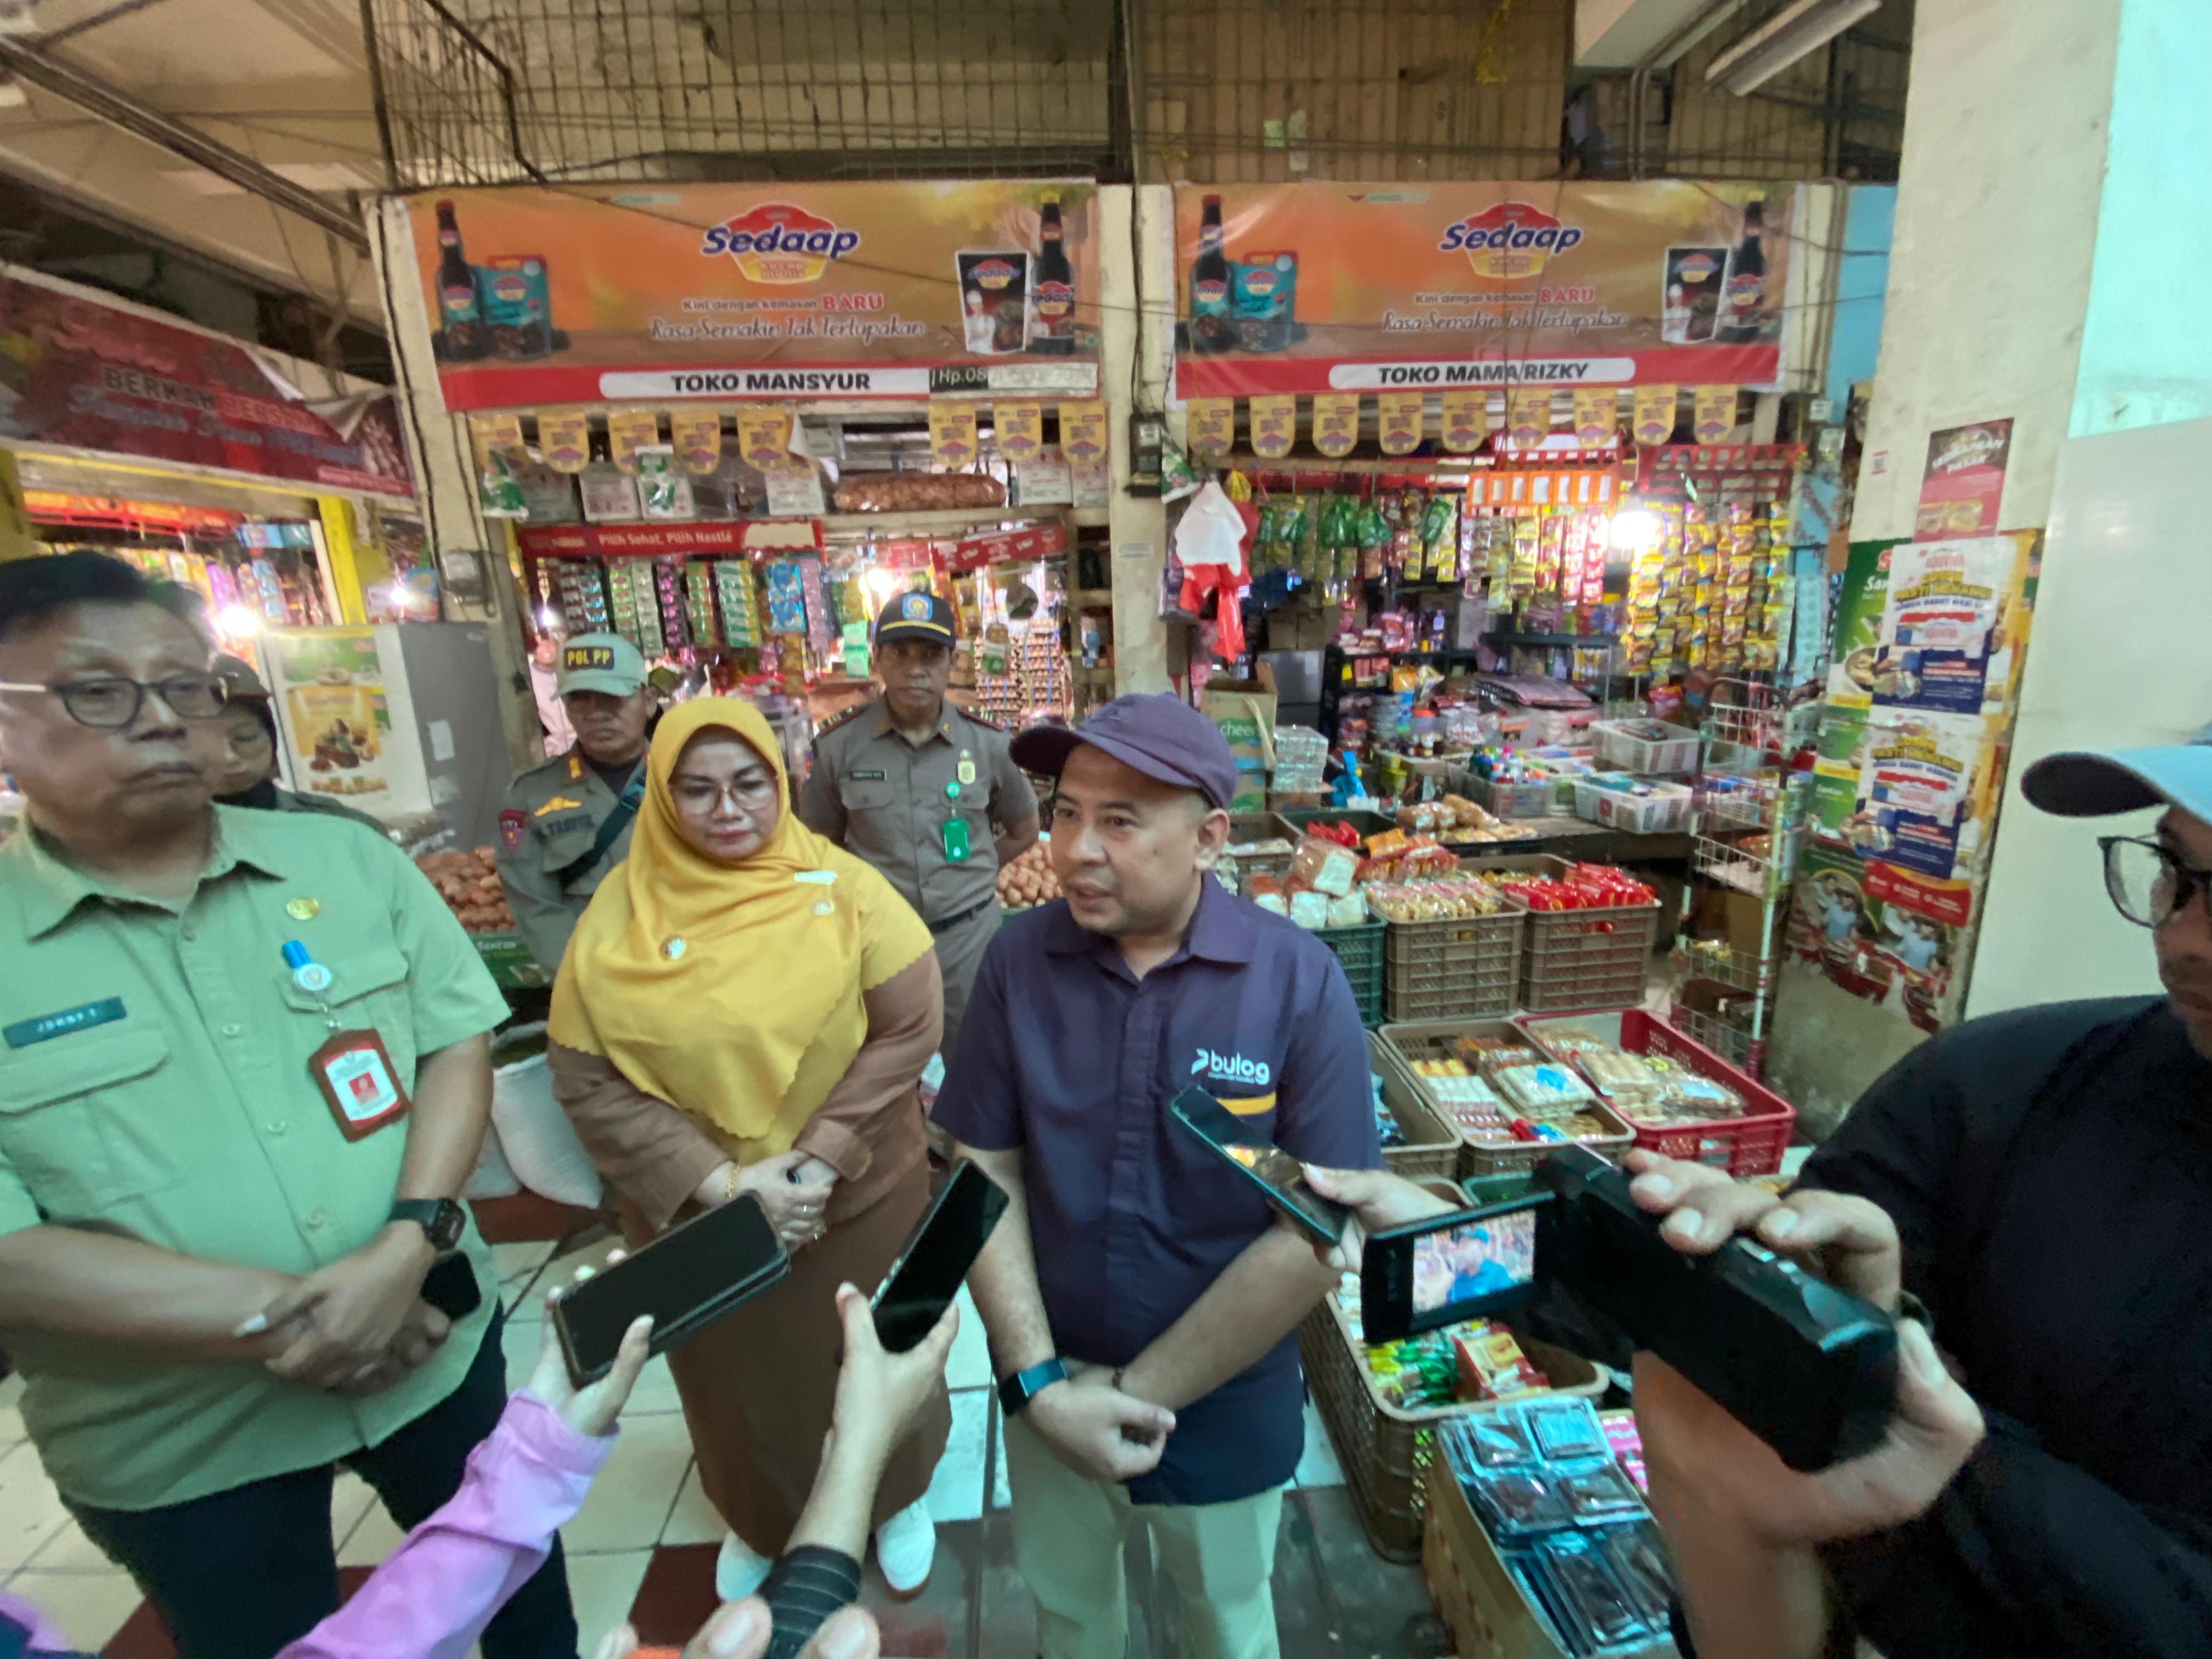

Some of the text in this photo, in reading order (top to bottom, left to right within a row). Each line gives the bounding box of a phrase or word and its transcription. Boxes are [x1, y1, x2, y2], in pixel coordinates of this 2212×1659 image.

[702, 225, 859, 259] Sedaap
[1440, 222, 1581, 253] Sedaap
[684, 295, 883, 311] Kini dengan kemasan BARU
[1415, 288, 1594, 304] Kini dengan kemasan BARU
[652, 318, 694, 338] Rasa
[701, 318, 782, 337] Semakin
[1383, 312, 1421, 330] Rasa
[1427, 311, 1498, 329] Semakin
[671, 373, 870, 391] TOKO MANSYUR
[1379, 362, 1588, 383] TOKO MAMA RIZKY
[598, 533, 625, 546] Pilih
[666, 531, 693, 544] Pilih
[695, 530, 732, 543] Nestlé
[568, 649, 610, 666] POL PP
[1210, 1043, 1269, 1085] bulog
